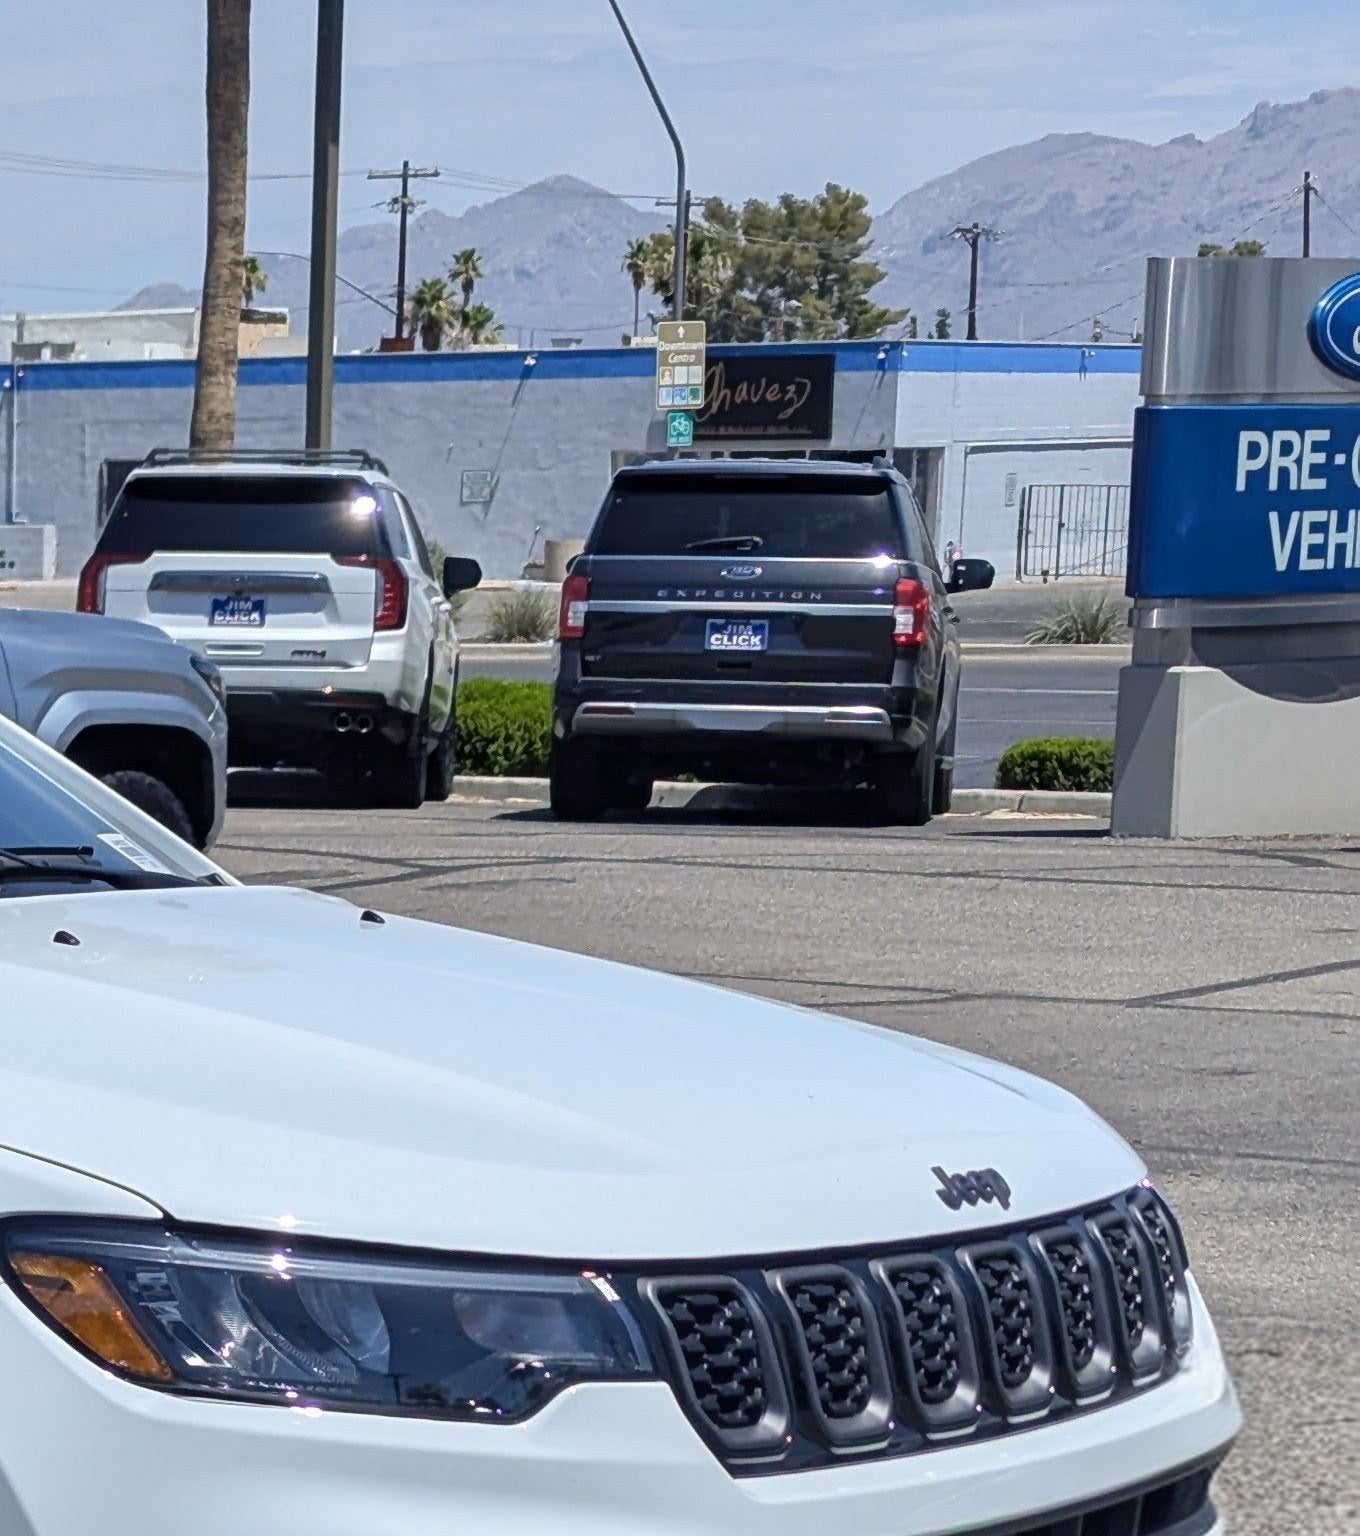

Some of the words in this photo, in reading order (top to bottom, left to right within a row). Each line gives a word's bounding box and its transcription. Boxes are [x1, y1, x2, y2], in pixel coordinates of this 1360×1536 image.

[1235, 429, 1360, 492] PRE-
[656, 589, 823, 600] EXPEDITION
[225, 600, 253, 610] JIM
[214, 610, 260, 621] CLICK
[723, 624, 753, 635] JIM
[710, 633, 762, 645] CLICK
[930, 1164, 1012, 1212] Jeep
